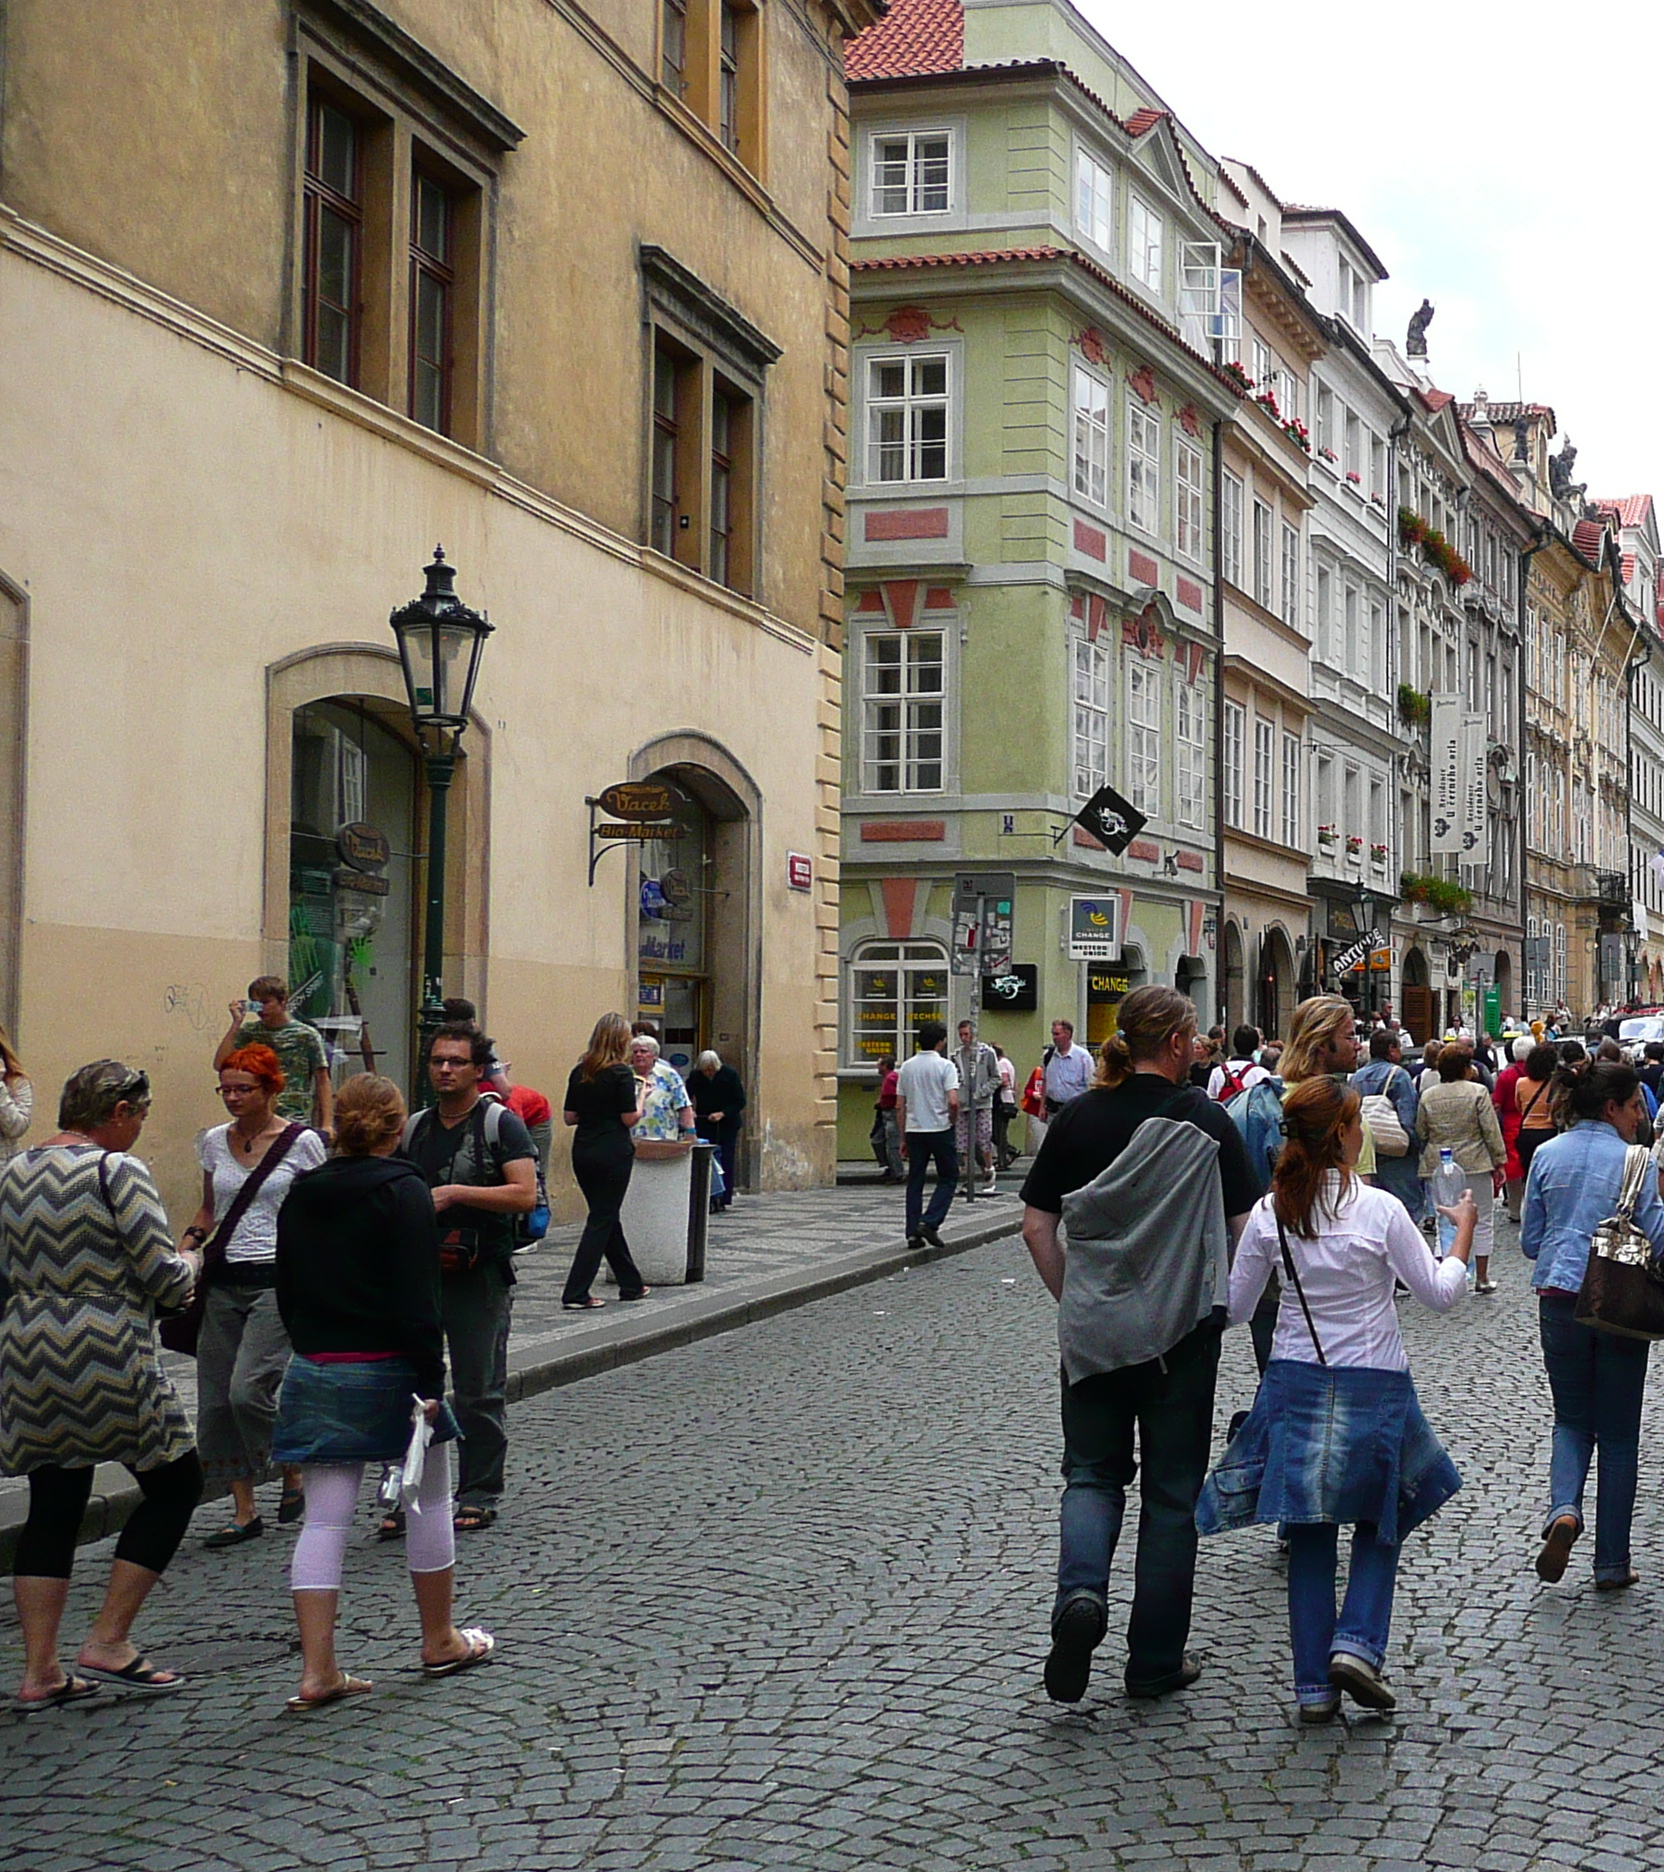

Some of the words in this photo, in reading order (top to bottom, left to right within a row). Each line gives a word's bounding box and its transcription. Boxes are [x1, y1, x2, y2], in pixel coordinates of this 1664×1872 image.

[1446, 739, 1457, 760] orla
[1474, 756, 1484, 776] orla
[601, 825, 678, 838] Bio-Market
[1075, 931, 1111, 939] CHANGE
[1091, 975, 1129, 993] CHANGE
